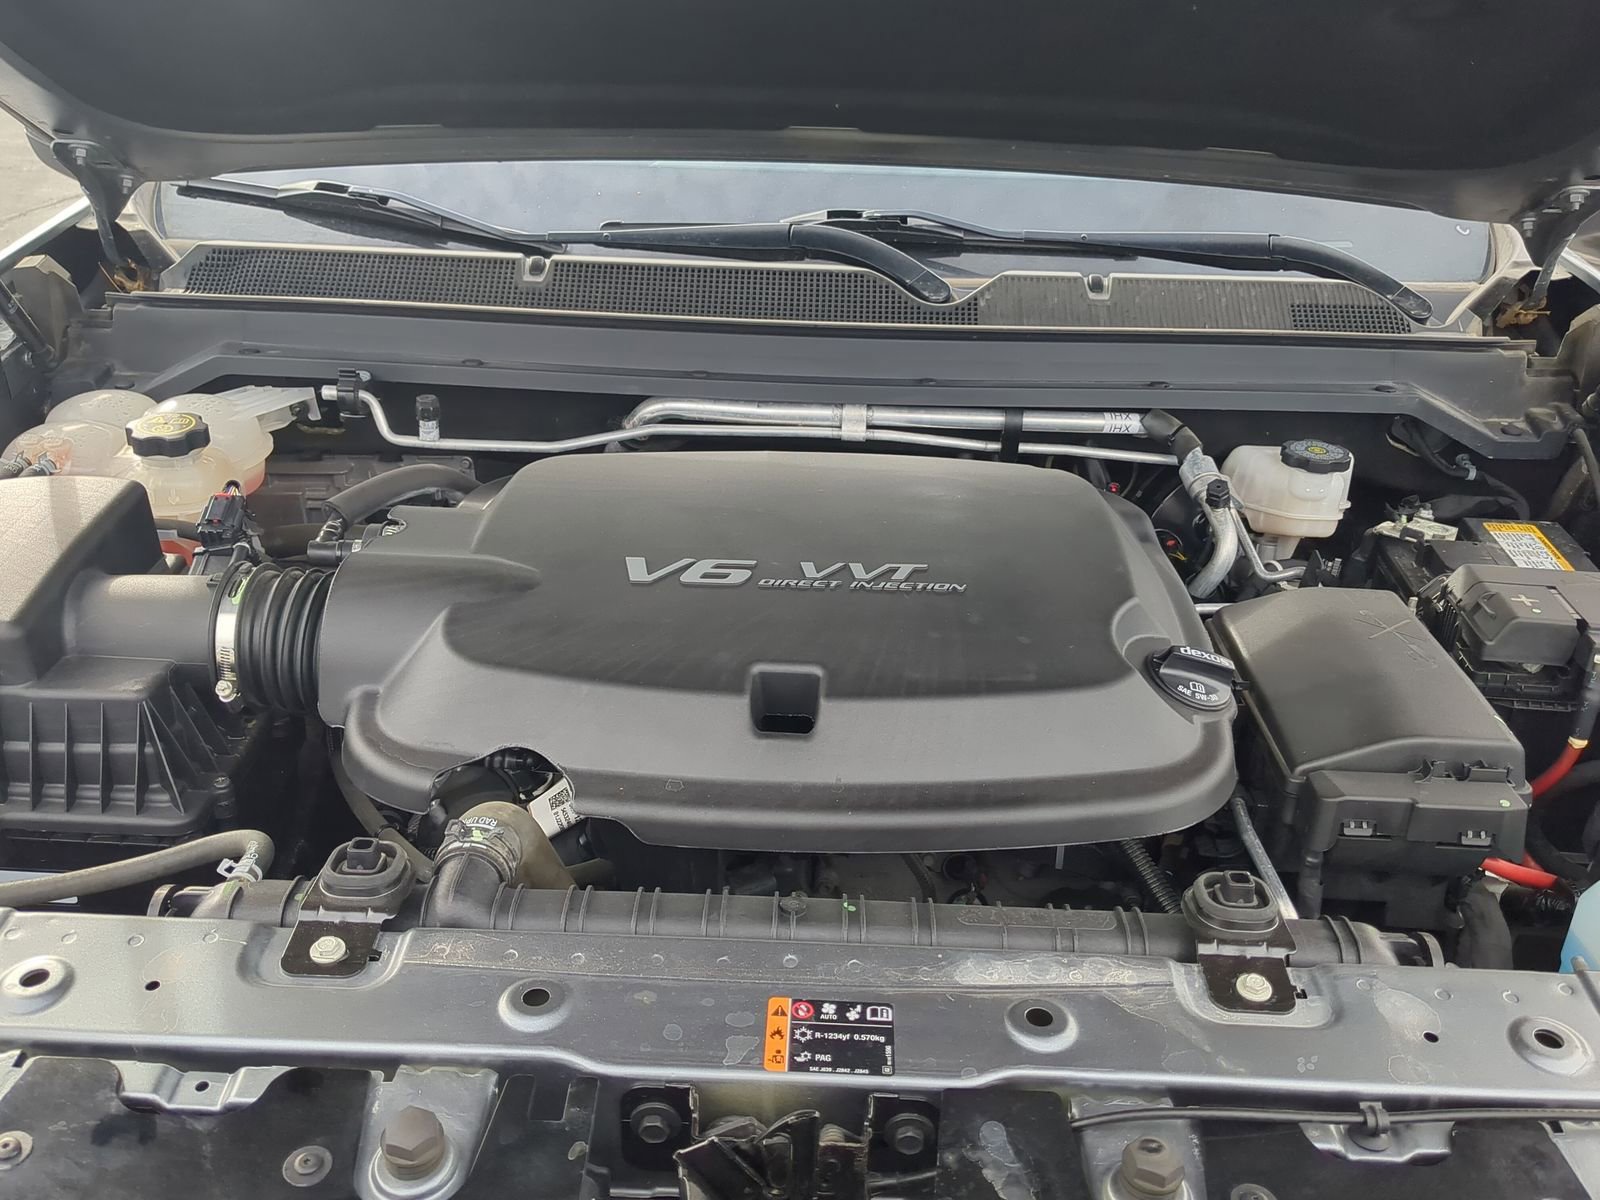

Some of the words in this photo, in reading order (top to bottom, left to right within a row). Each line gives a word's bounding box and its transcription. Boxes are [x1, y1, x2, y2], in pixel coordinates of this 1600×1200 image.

[624, 555, 758, 586] V6
[799, 560, 929, 583] VVT
[757, 577, 843, 590] DIRECT
[850, 579, 967, 593] INJECTION
[1179, 646, 1231, 667] dexos
[1177, 684, 1192, 697] SAE
[478, 816, 498, 827] RAD
[814, 1032, 850, 1041] R-1234yf
[853, 1033, 885, 1043] 0.570kg
[815, 1053, 832, 1062] PAG
